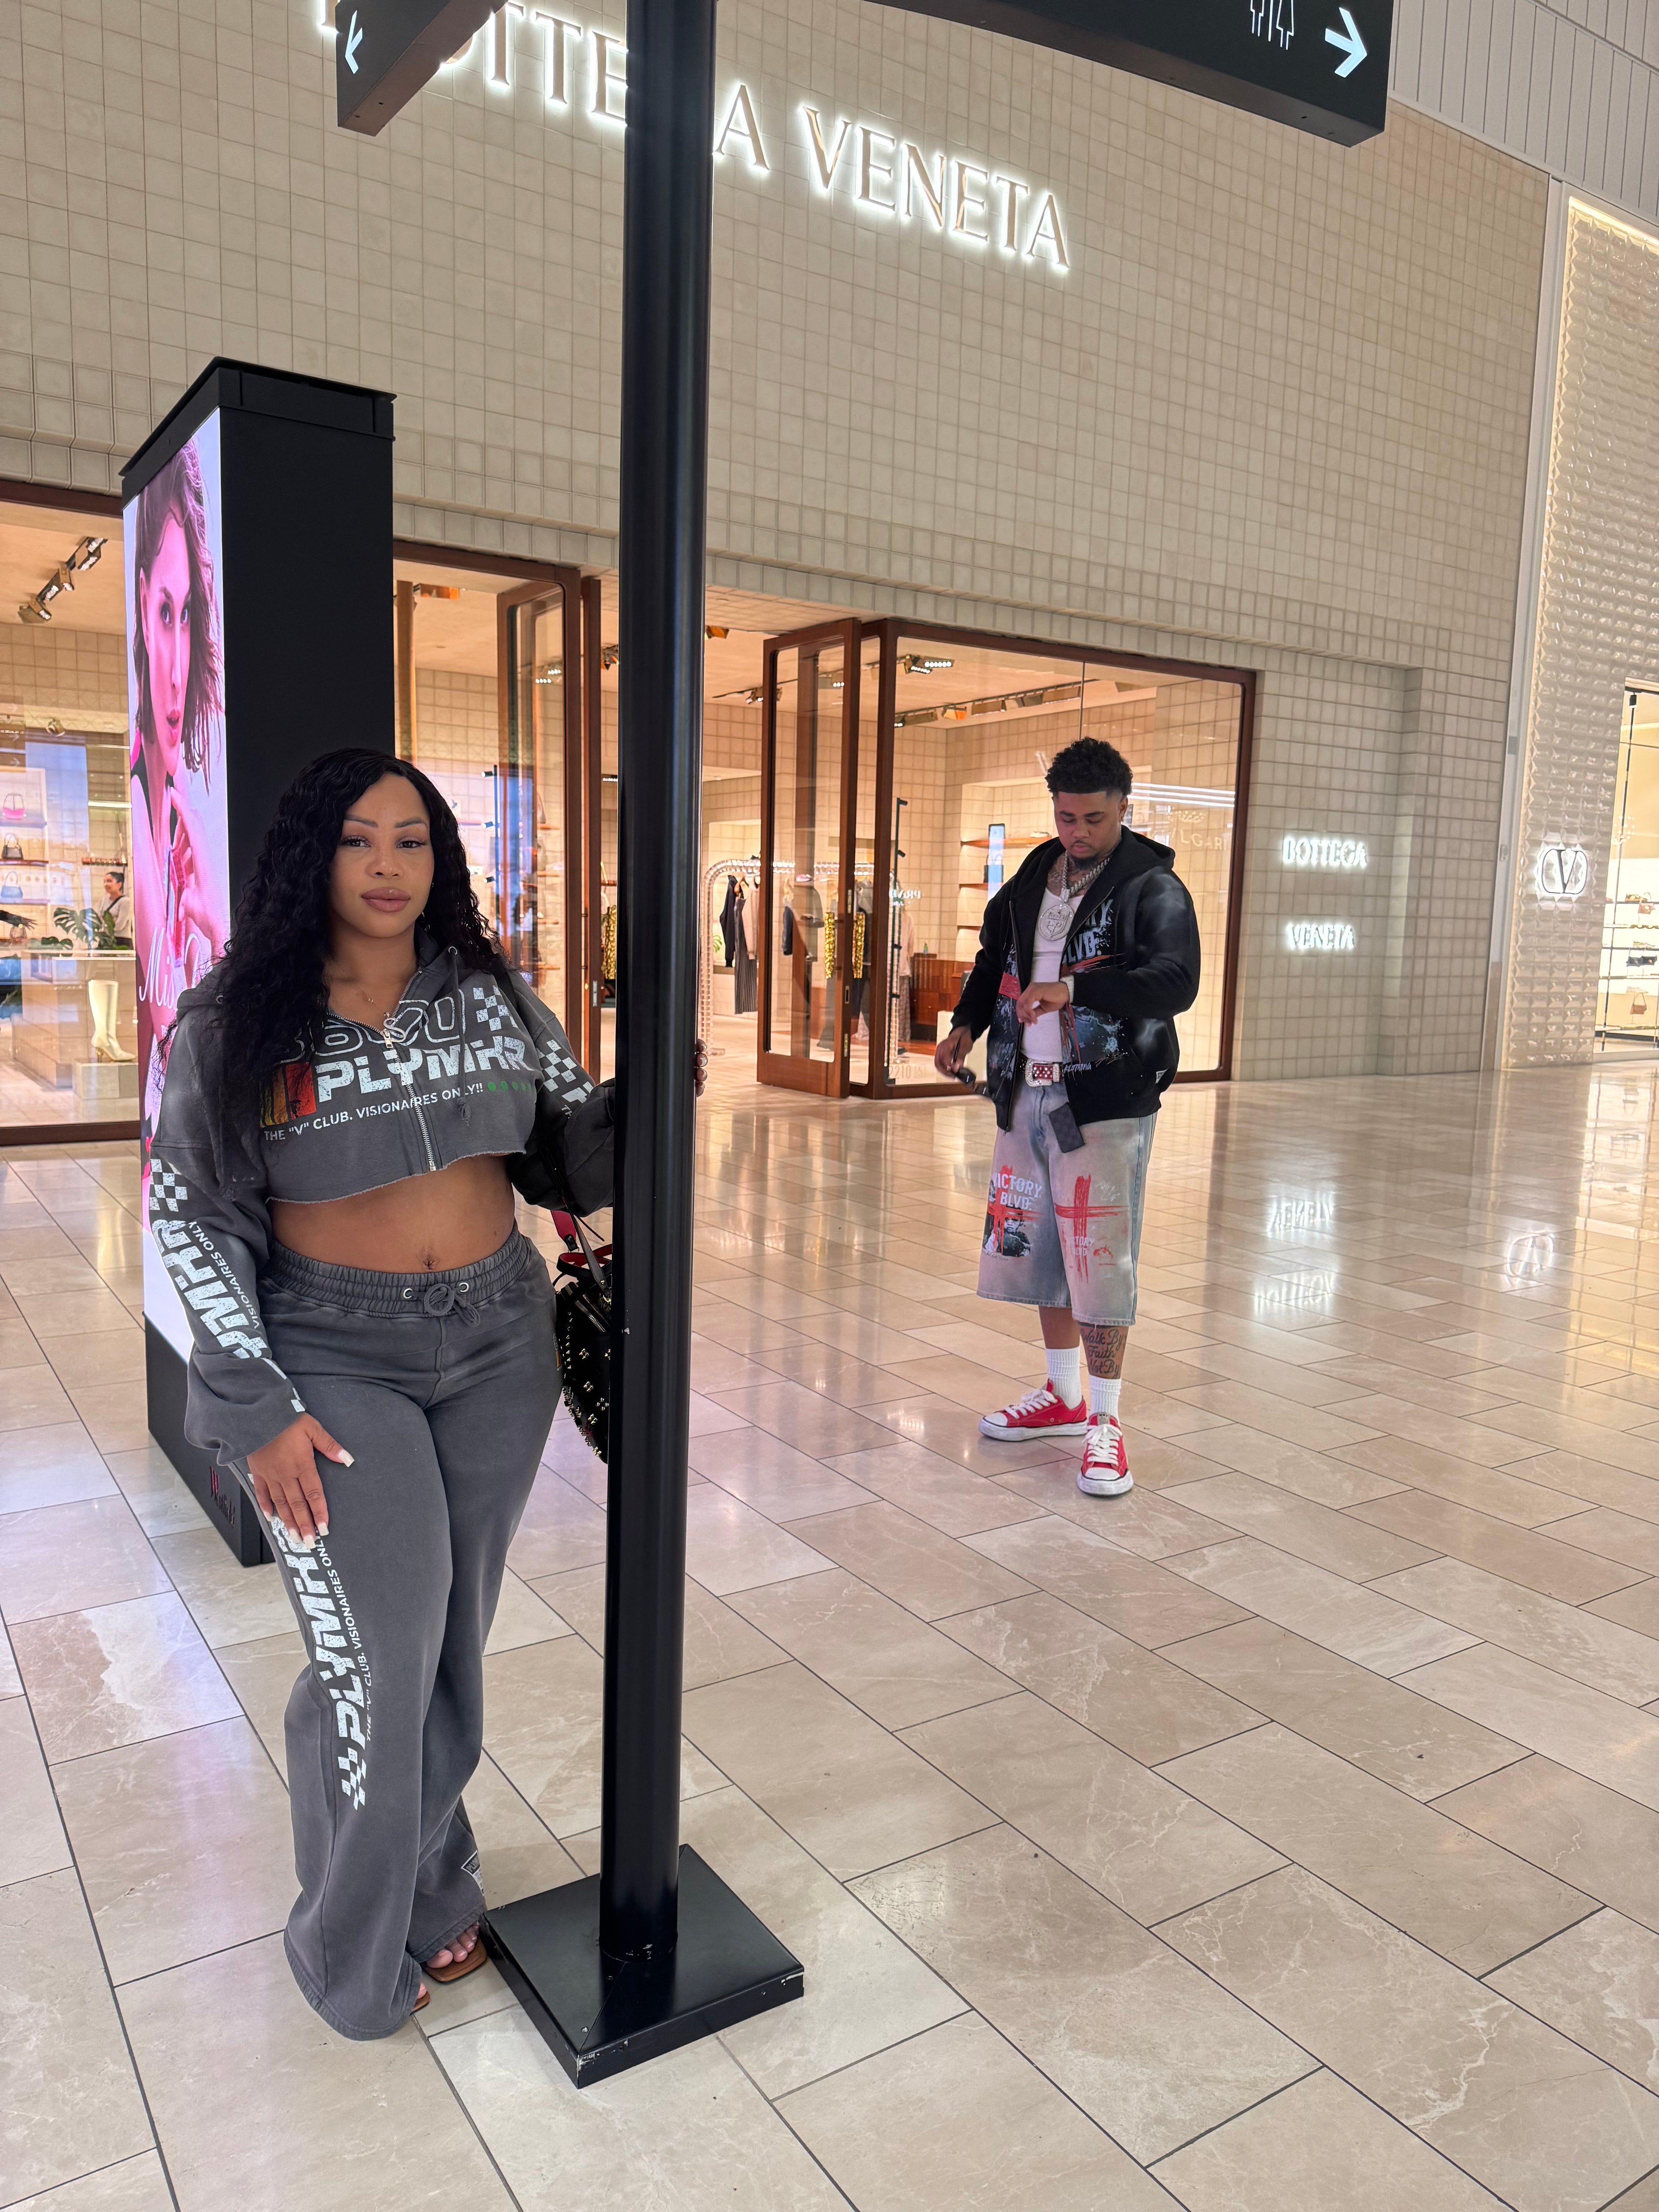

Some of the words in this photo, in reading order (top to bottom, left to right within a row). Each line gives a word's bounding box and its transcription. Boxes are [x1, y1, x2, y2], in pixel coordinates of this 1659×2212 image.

[800, 105, 1071, 271] VENETA
[1281, 837, 1368, 867] BOTTEGA
[1285, 923, 1356, 950] VENETA
[264, 1129, 286, 1141] THE
[289, 1121, 309, 1135] "V"
[313, 1109, 353, 1130] CLUB.
[356, 1092, 438, 1119] VISIONAIRES
[992, 1172, 1042, 1198] VICTORY
[187, 1220, 214, 1252] ONLY
[210, 1251, 260, 1329] VISIONAIRES
[1081, 1329, 1105, 1345] Walk
[1106, 1328, 1123, 1351] By
[1087, 1345, 1116, 1359] Faith
[327, 1569, 362, 1650] VISIONAIRES
[357, 1652, 372, 1687] CLUB.
